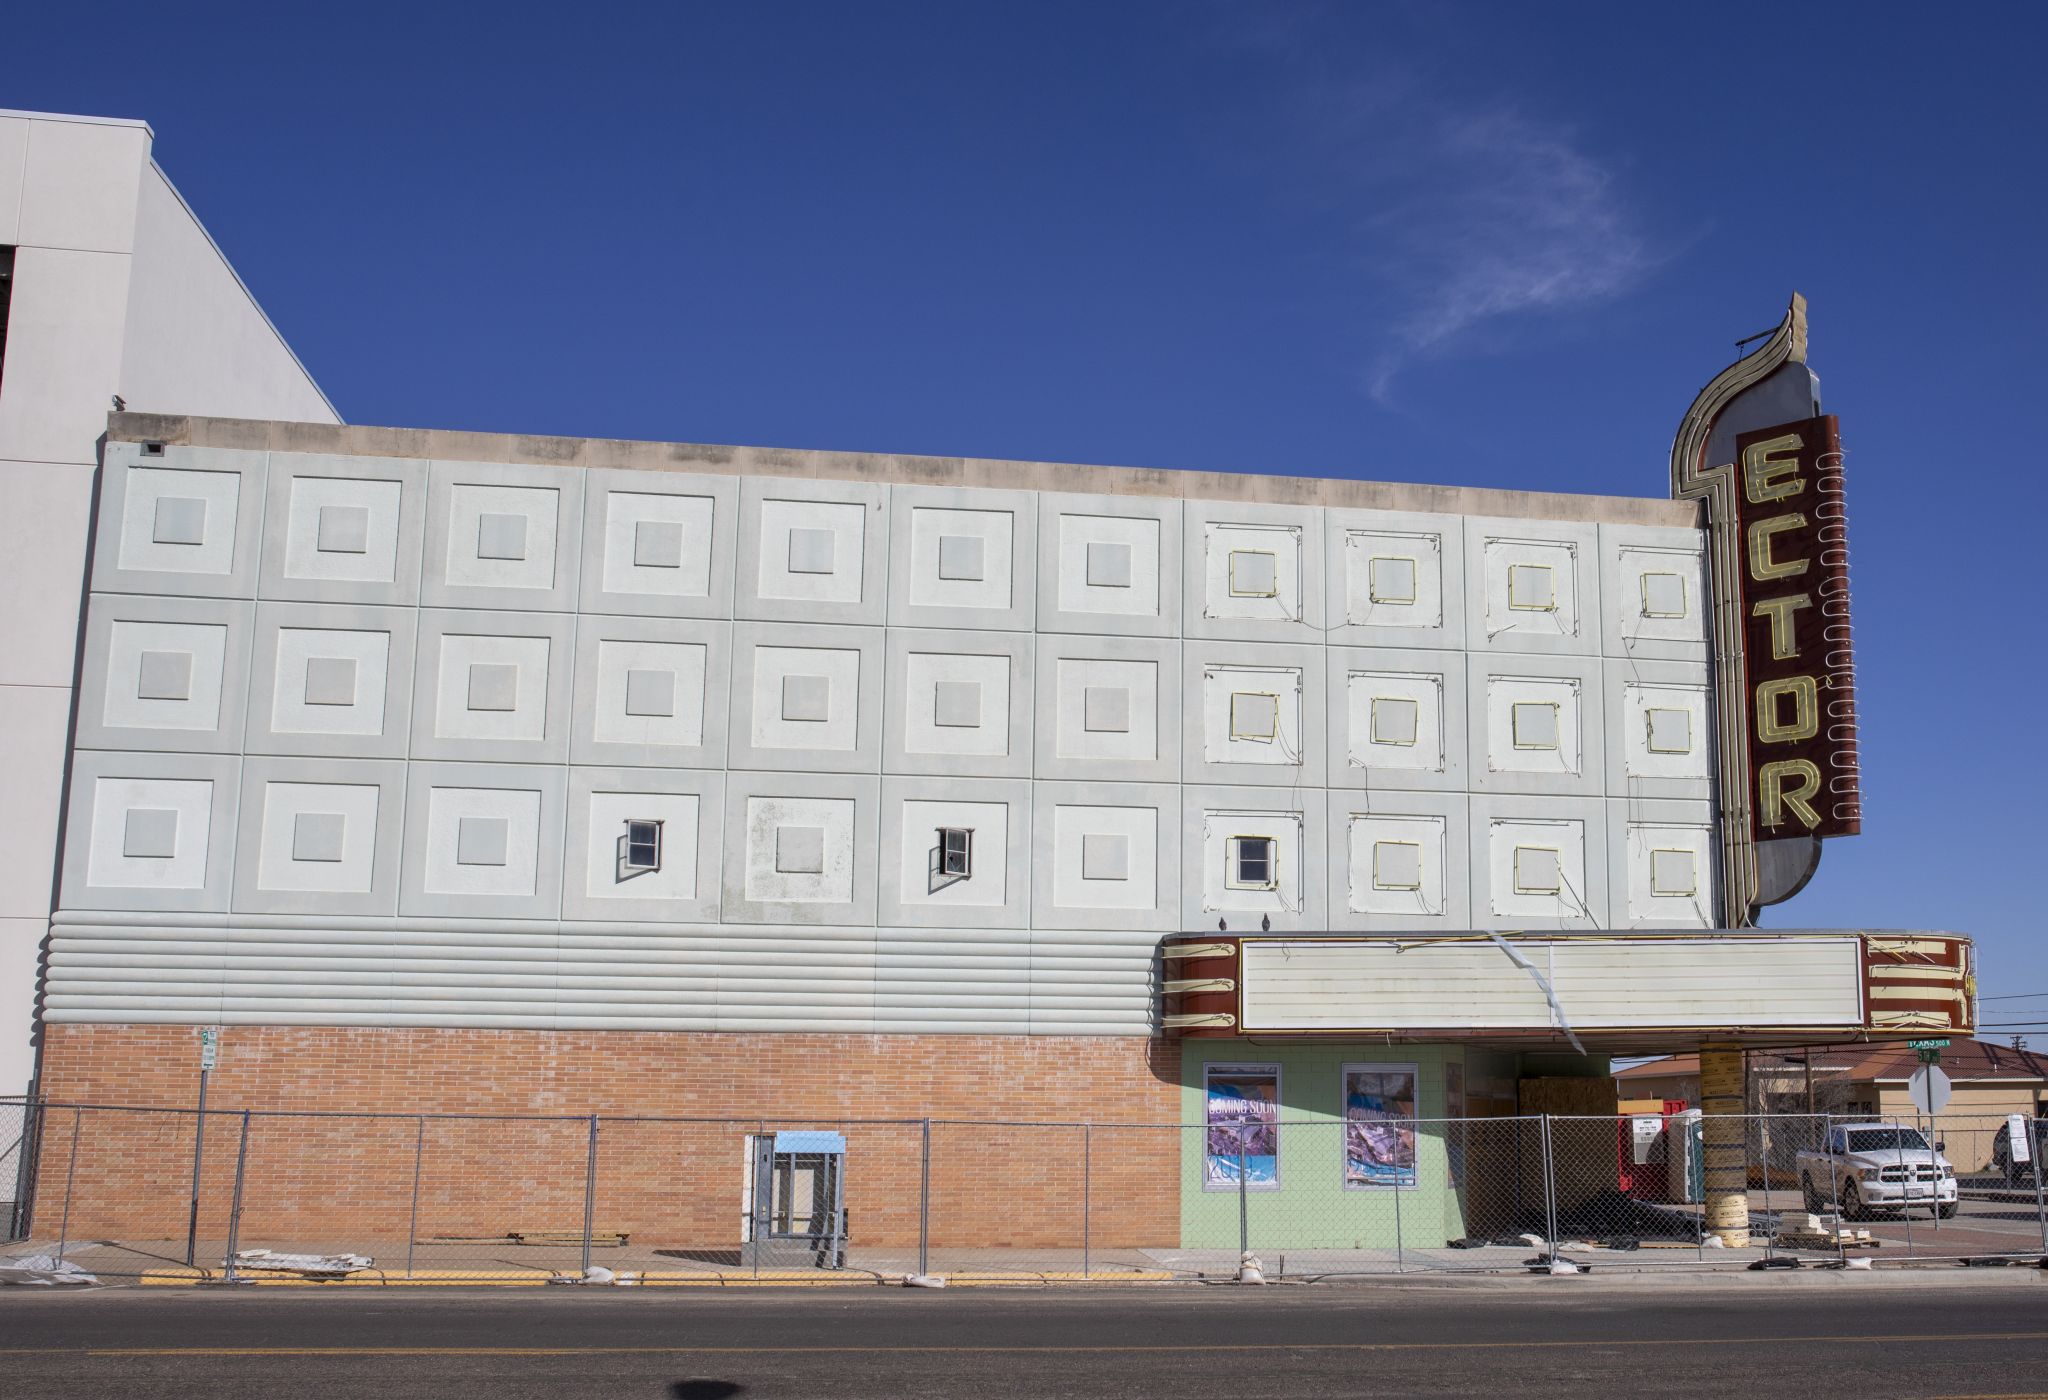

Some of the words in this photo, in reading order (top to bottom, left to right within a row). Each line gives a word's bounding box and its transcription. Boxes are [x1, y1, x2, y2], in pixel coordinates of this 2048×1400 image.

[1742, 433, 1821, 830] ECTOR
[1208, 1099, 1247, 1114] COMING
[1249, 1099, 1277, 1114] SOON
[1349, 1107, 1387, 1125] COMING
[1389, 1112, 1414, 1128] SOON
